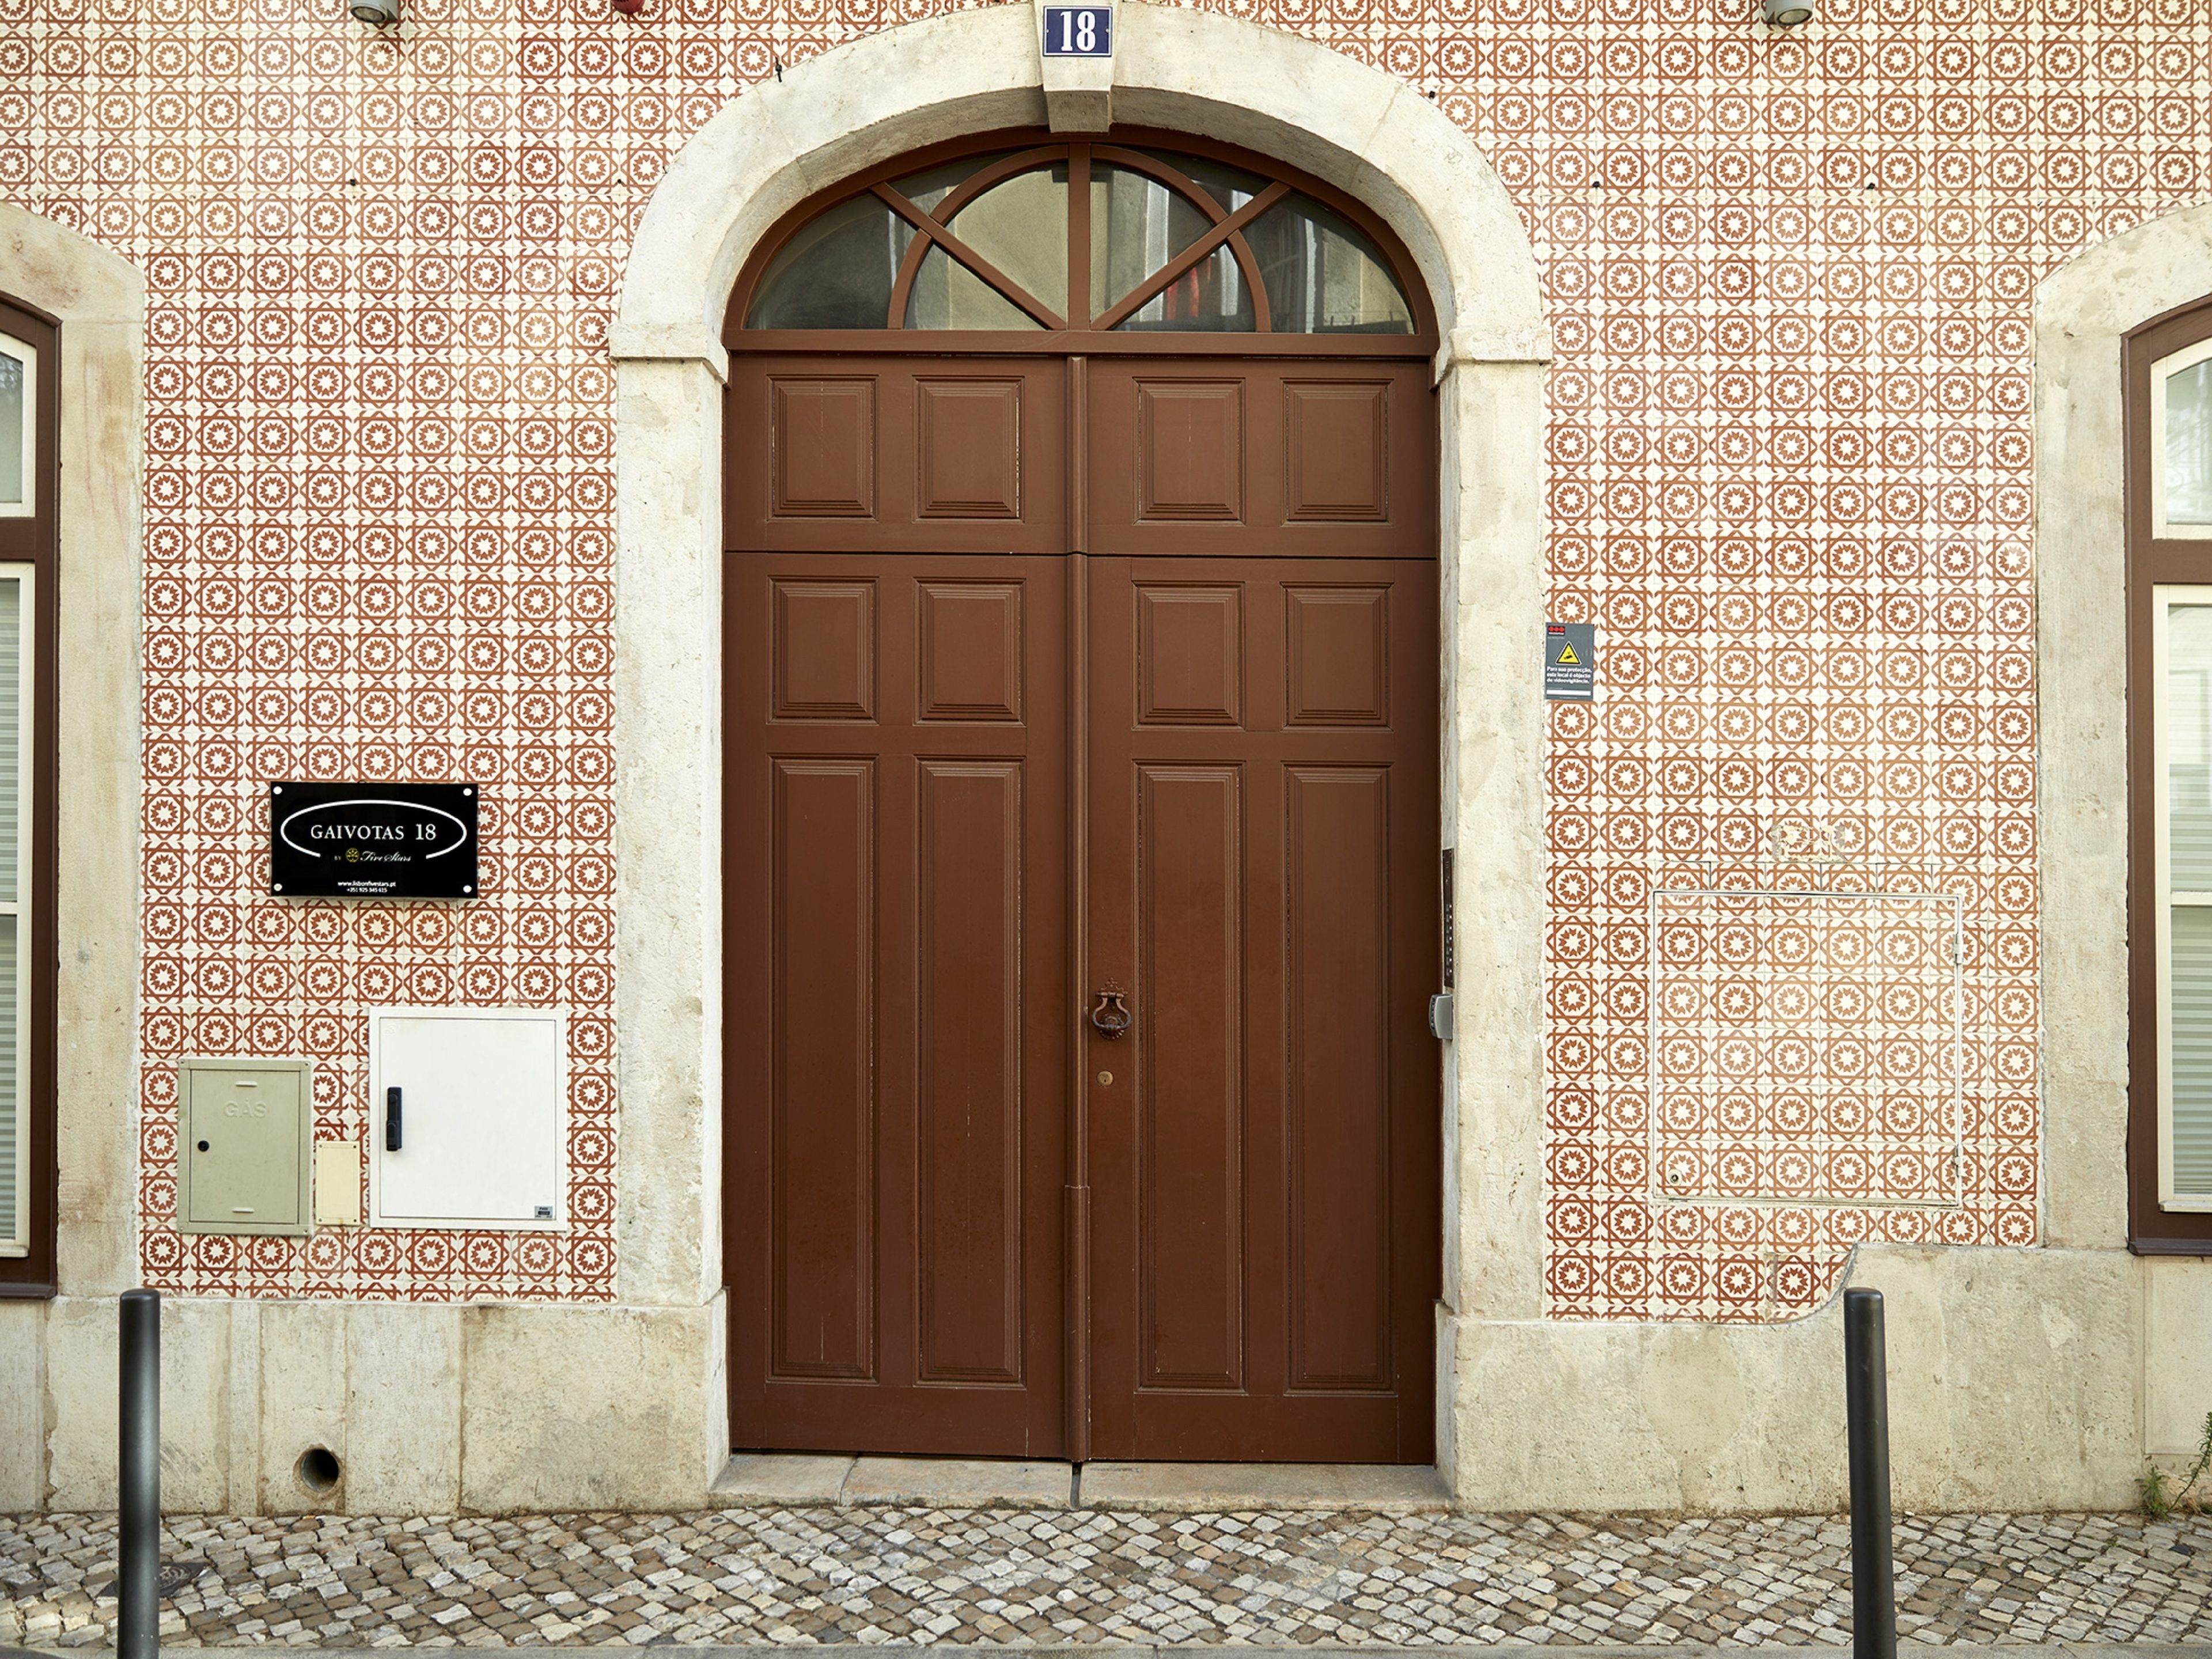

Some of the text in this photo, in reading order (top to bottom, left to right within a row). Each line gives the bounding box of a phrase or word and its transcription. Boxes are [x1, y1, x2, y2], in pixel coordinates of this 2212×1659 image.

[1060, 10, 1096, 52] 18
[310, 823, 437, 840] GAIVOTAS 18
